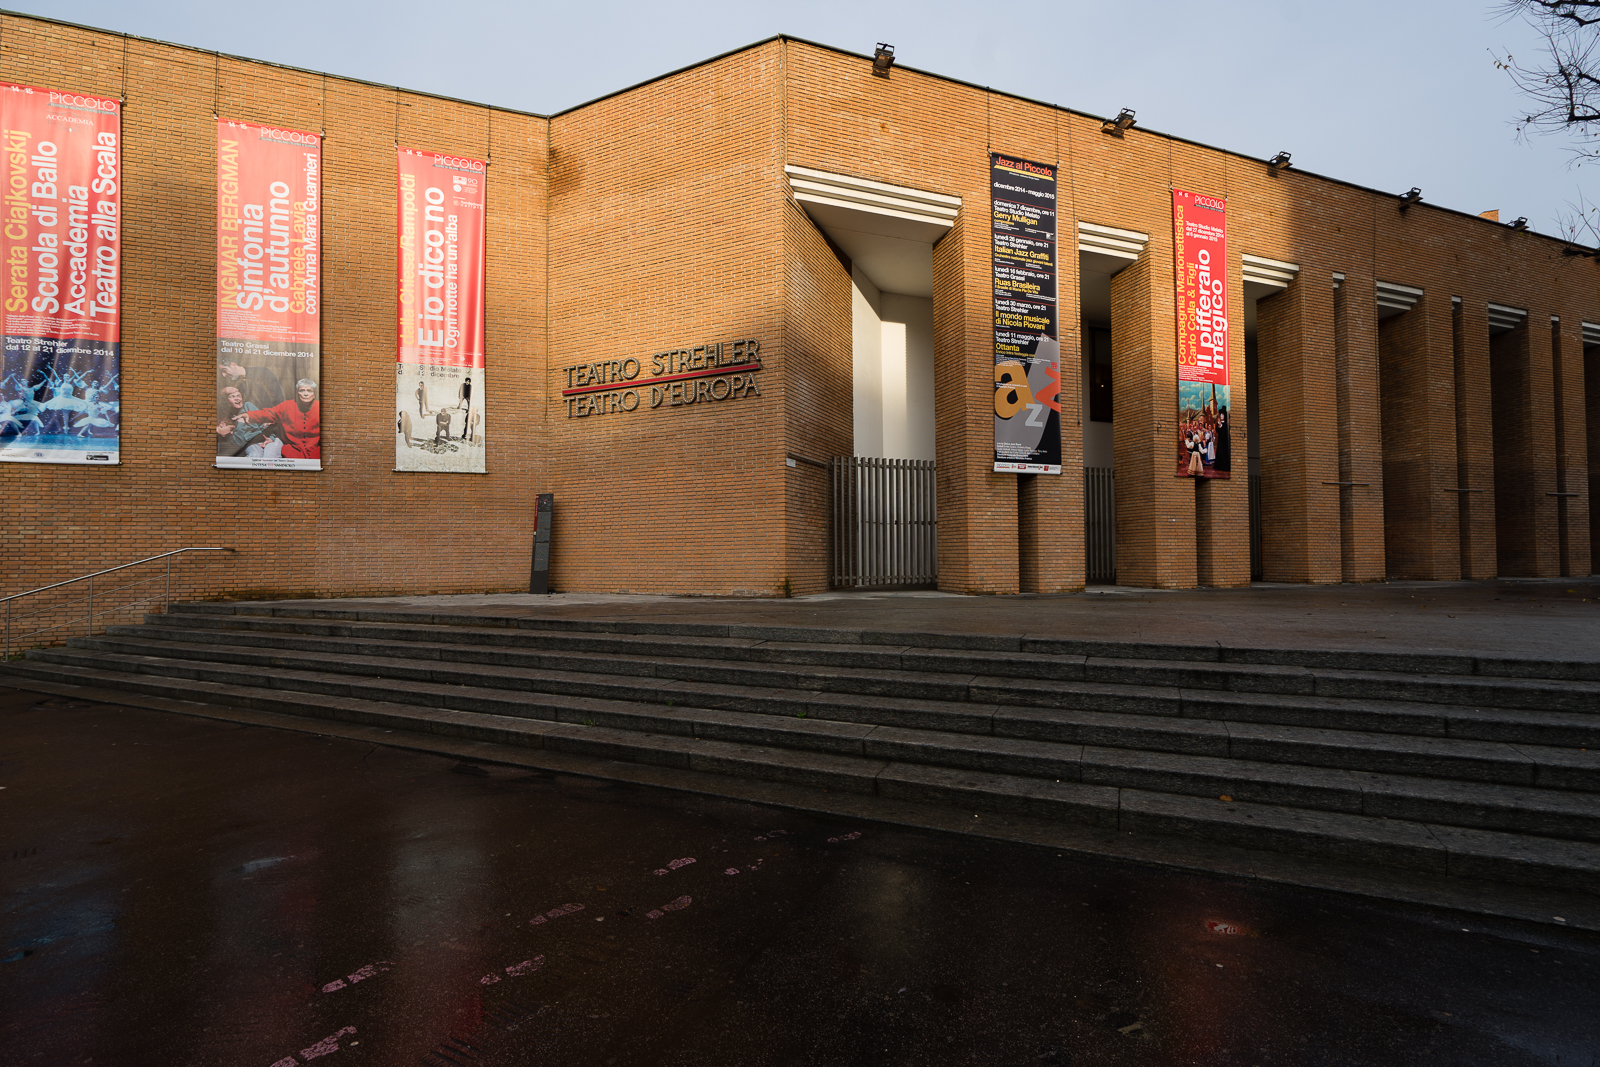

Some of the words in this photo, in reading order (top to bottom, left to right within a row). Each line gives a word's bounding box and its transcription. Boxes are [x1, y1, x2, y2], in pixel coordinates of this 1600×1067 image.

[50, 92, 116, 111] PICCOLO
[46, 114, 94, 126] ACCADEMIA
[260, 126, 317, 145] PICCOLO
[32, 141, 58, 200] Ballo
[92, 132, 116, 195] Scala
[434, 154, 483, 170] PICCOLO
[996, 156, 1014, 168] Jazz
[1024, 163, 1052, 176] Piccolo
[4, 130, 32, 240] Ciajkovskij
[221, 140, 238, 231] BERGMAN
[303, 153, 318, 212] Guarnieri
[994, 182, 1014, 191] dicembre
[1028, 189, 1044, 198] maggio
[32, 206, 58, 227] di
[425, 187, 445, 222] no
[994, 200, 1016, 209] domenica
[994, 211, 1011, 222] Gerry
[1012, 214, 1038, 225] Mulligan
[1195, 195, 1224, 210] PICCOLO
[92, 201, 116, 240] alla
[290, 201, 306, 242] Lavia
[304, 214, 317, 250] Maria
[62, 185, 88, 316] Accademia
[236, 204, 264, 310] Sinfonia
[263, 181, 290, 312] d'autunno
[400, 173, 418, 308] Chiesa/Rampoldi
[994, 245, 1013, 254] Italian
[1014, 249, 1028, 257] Jazz
[1175, 205, 1185, 293] Marionettistica
[32, 233, 59, 314] Scuola
[221, 236, 238, 308] INGMAR
[303, 253, 316, 288] Anna
[418, 230, 444, 289] dico
[446, 266, 457, 283] ha
[1186, 262, 1197, 286] Figli
[6, 246, 27, 312] Serata
[90, 246, 116, 316] Teatro
[290, 244, 306, 314] Gabriele
[995, 278, 1011, 286] Ruas
[1012, 280, 1040, 291] Brasileira
[1187, 290, 1196, 299] &
[306, 290, 316, 315] con
[418, 296, 444, 321] io
[446, 284, 457, 316] notte
[1187, 301, 1196, 331] Colla
[1195, 249, 1215, 351] pifferaio
[400, 310, 415, 345] dalla
[445, 318, 460, 348] Ogni
[1002, 319, 1022, 327] Nicola
[1024, 321, 1045, 330] Piovani
[1024, 315, 1050, 324] musicale
[1178, 296, 1187, 365] Compagnia
[1211, 279, 1228, 369] magico
[34, 338, 68, 348] Strehler
[418, 328, 444, 348] E
[996, 343, 1019, 351] Ottanta
[1188, 334, 1197, 365] Carlo
[563, 357, 640, 387] TEATRO
[650, 338, 761, 375] STREHLER
[1197, 354, 1212, 368] Il
[563, 389, 640, 418] TEATRO
[650, 372, 761, 408] D'EUROPA
